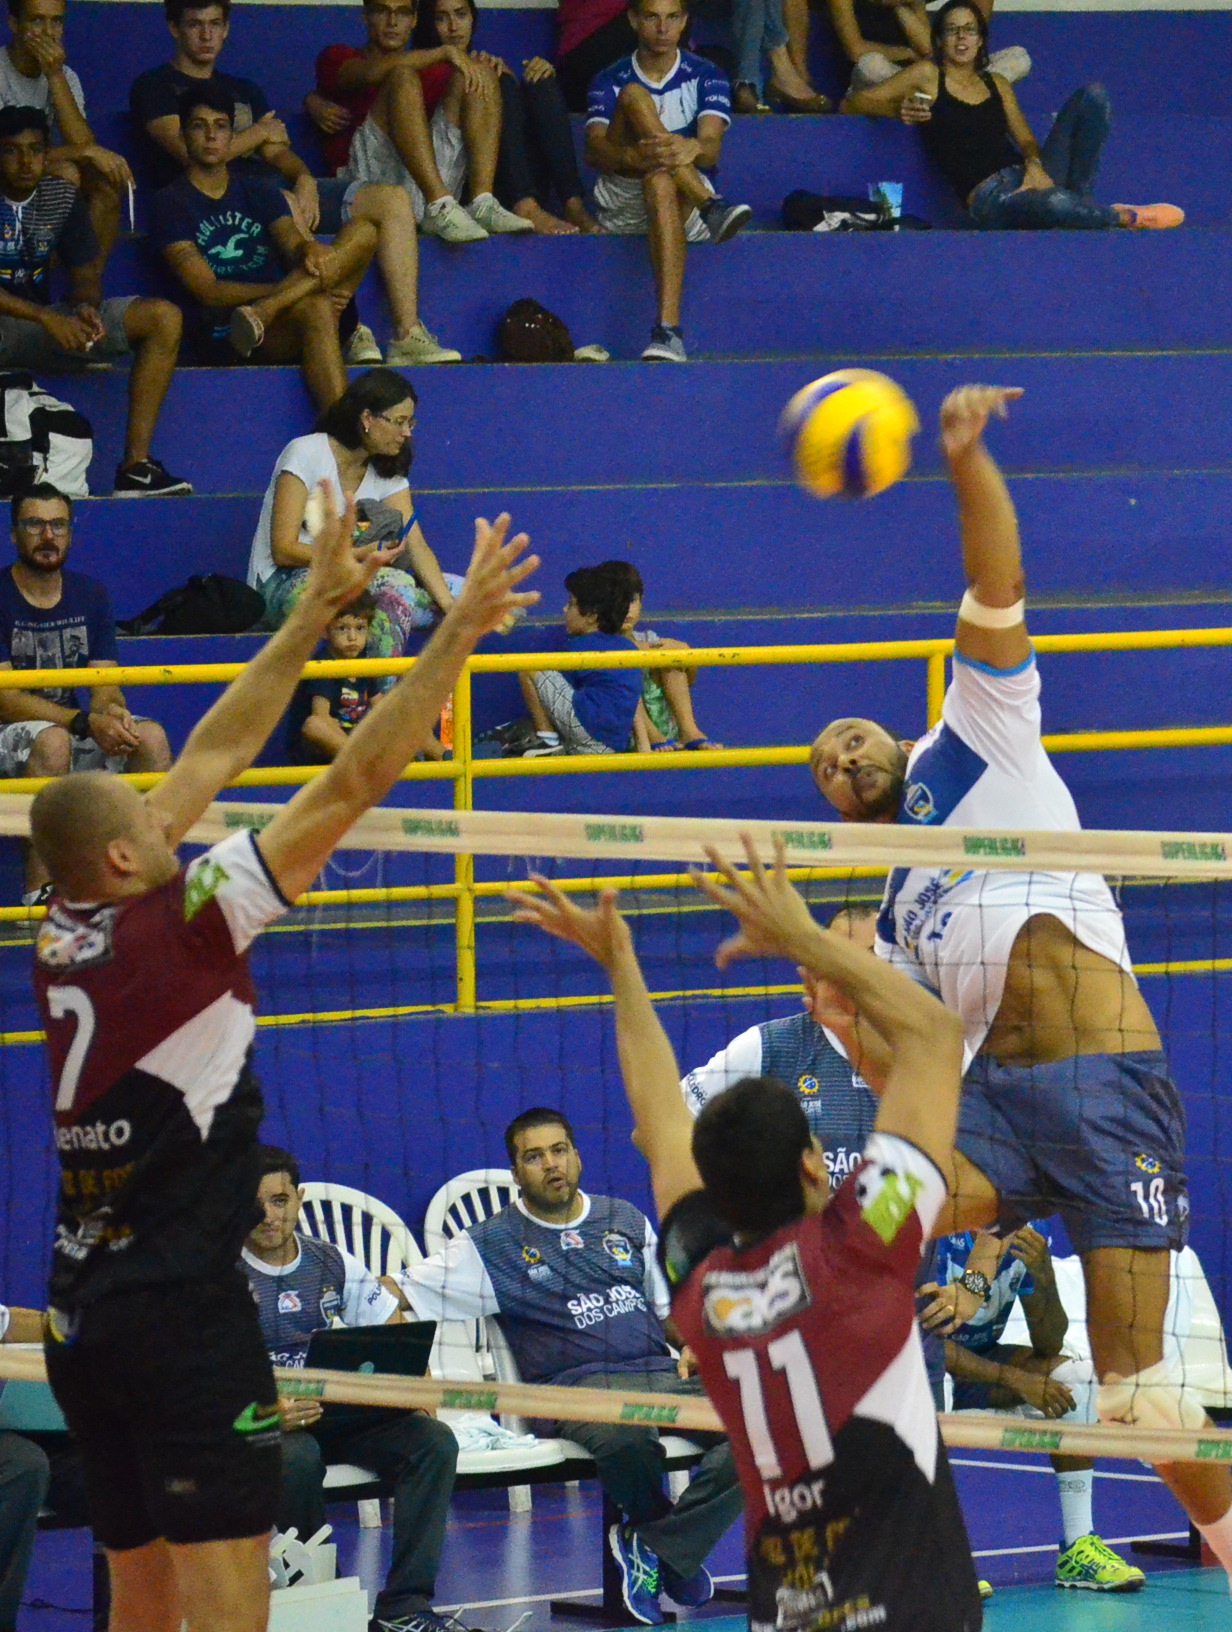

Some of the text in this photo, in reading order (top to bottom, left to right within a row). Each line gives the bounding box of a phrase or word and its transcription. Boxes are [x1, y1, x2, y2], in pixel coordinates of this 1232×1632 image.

[196, 211, 261, 246] HOLLISTER
[822, 1147, 863, 1174] SÃO
[1130, 1177, 1169, 1227] 10
[567, 1293, 605, 1316] SÃO
[574, 1298, 648, 1330] DOS CAMP
[721, 1328, 836, 1480] 11
[762, 1478, 825, 1524] Igor
